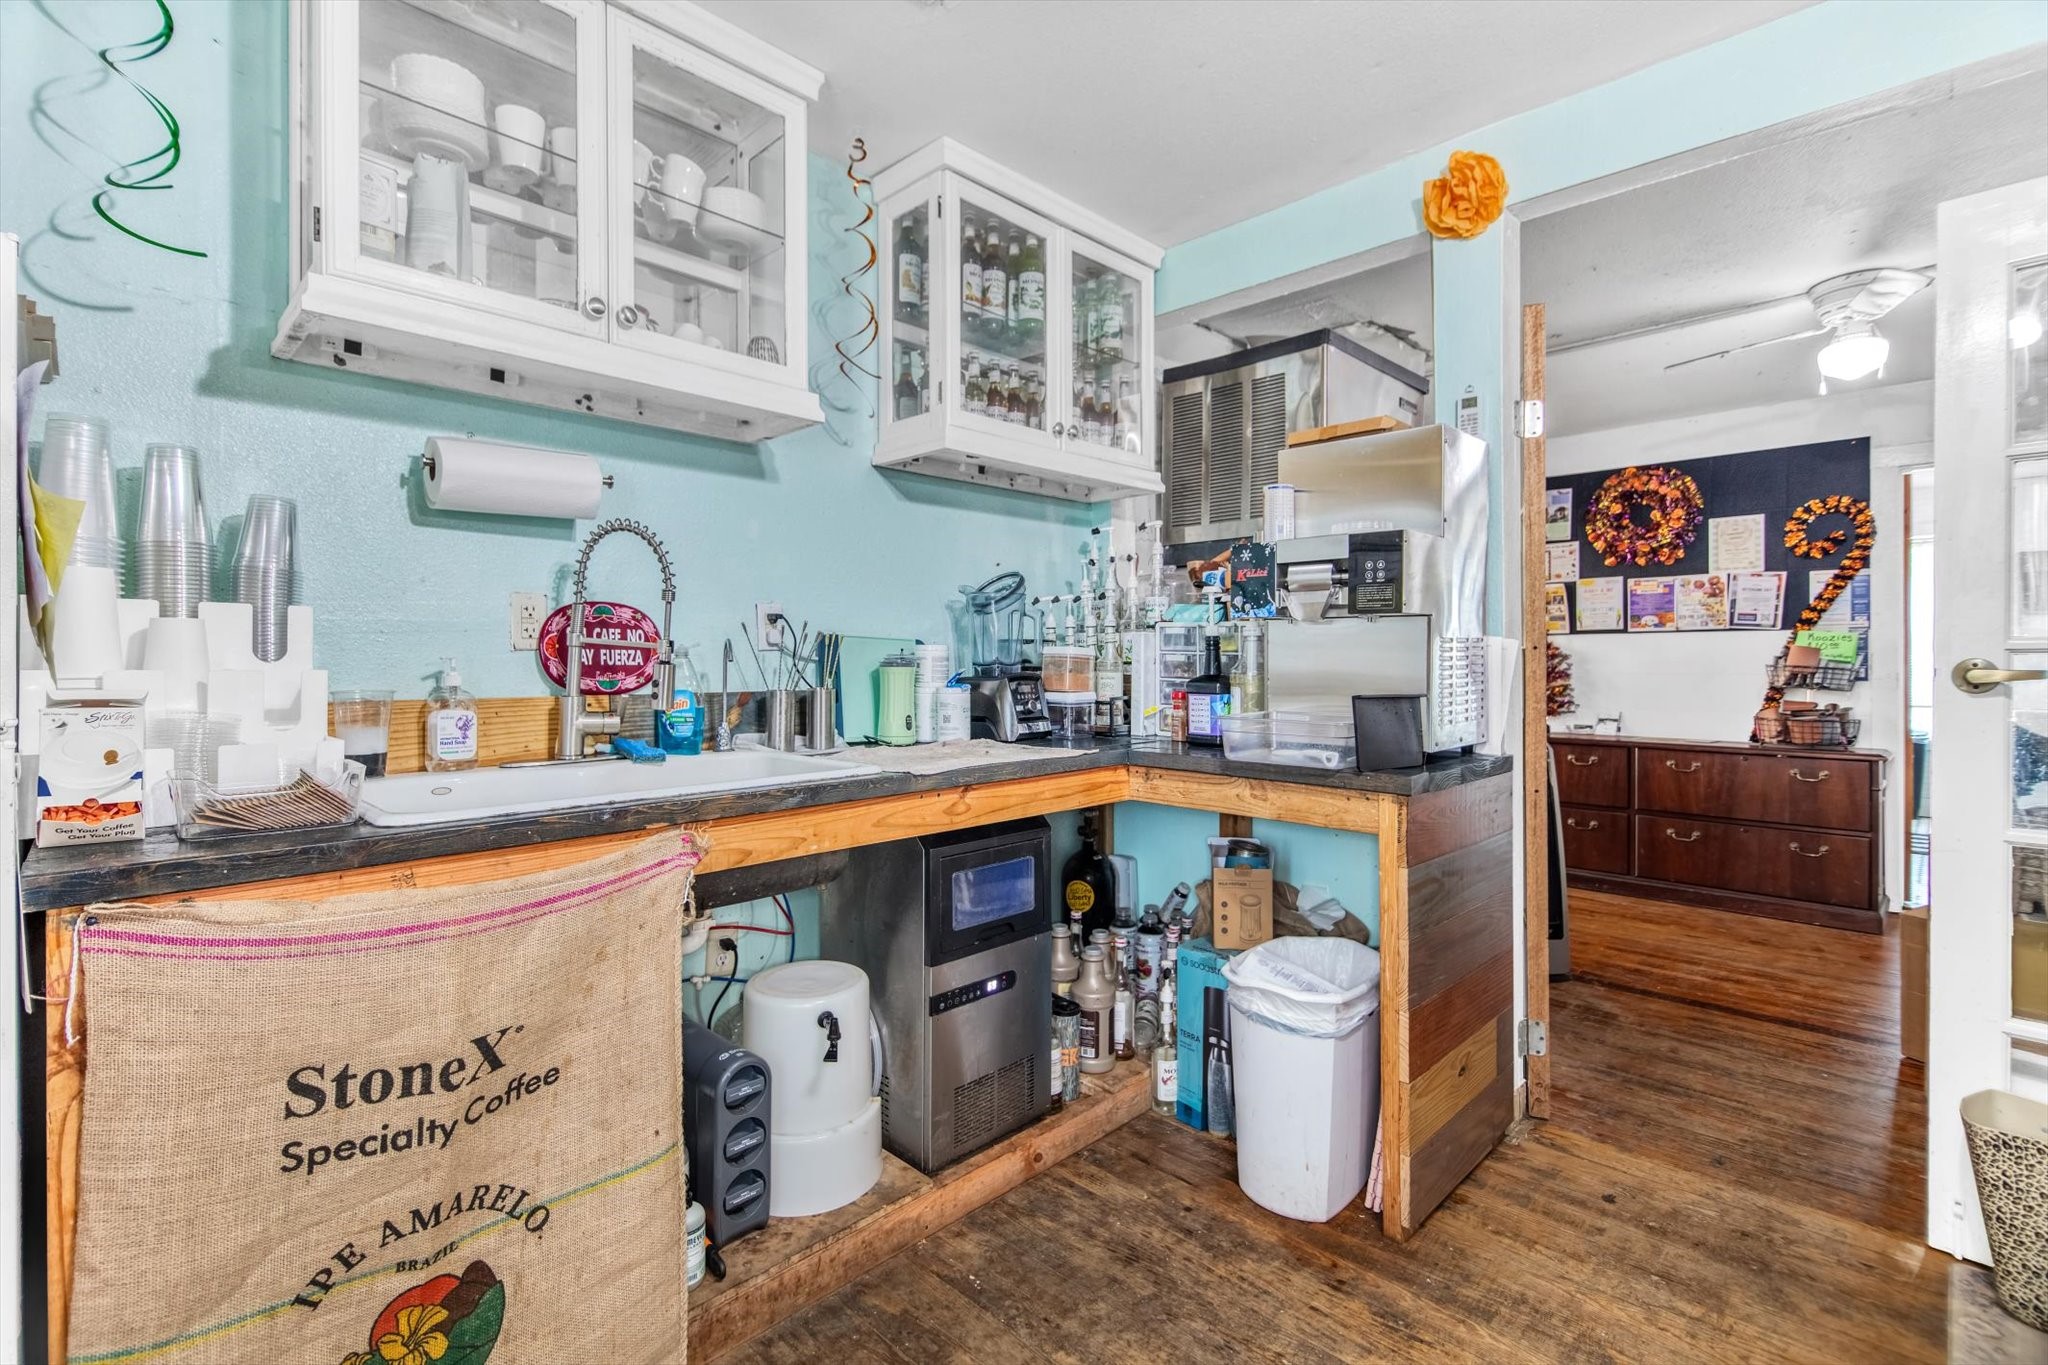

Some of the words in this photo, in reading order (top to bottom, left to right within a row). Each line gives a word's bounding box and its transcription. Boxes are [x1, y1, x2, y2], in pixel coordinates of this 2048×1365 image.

[626, 629, 645, 643] NO
[581, 649, 594, 665] AY
[600, 649, 644, 666] FUERZA
[102, 822, 134, 832] Coffee
[114, 829, 136, 837] Plug
[1180, 1028, 1201, 1043] TERRA
[280, 1116, 460, 1176] Specialty
[463, 1065, 561, 1126] Coffee
[290, 1241, 368, 1312] IPE
[378, 1183, 551, 1249] AMARELO
